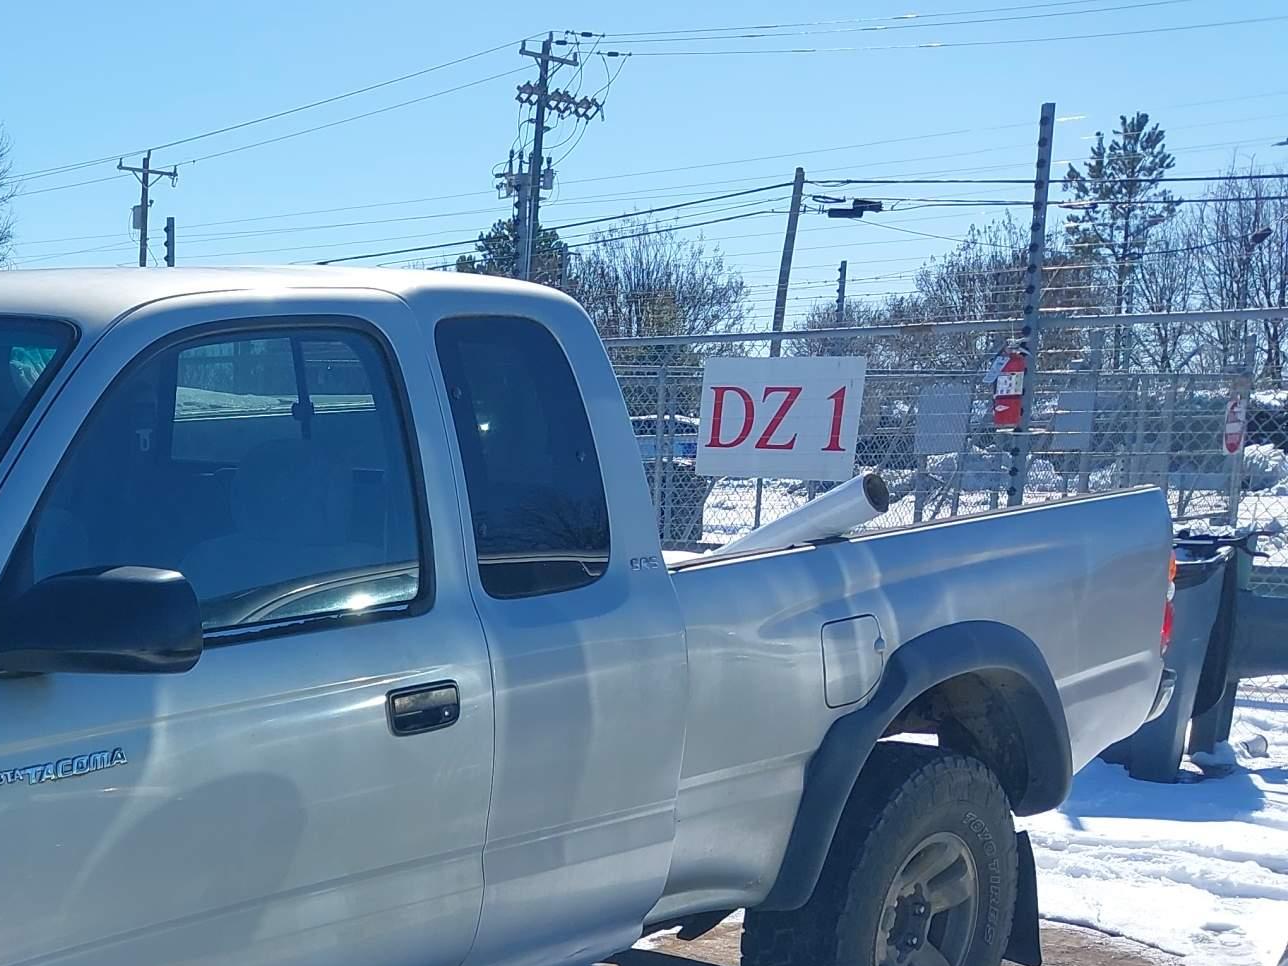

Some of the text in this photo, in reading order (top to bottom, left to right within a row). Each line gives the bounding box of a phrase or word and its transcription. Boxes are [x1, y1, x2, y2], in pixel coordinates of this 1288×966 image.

[705, 386, 847, 452] DZ 1
[23, 747, 128, 785] TACOMA
